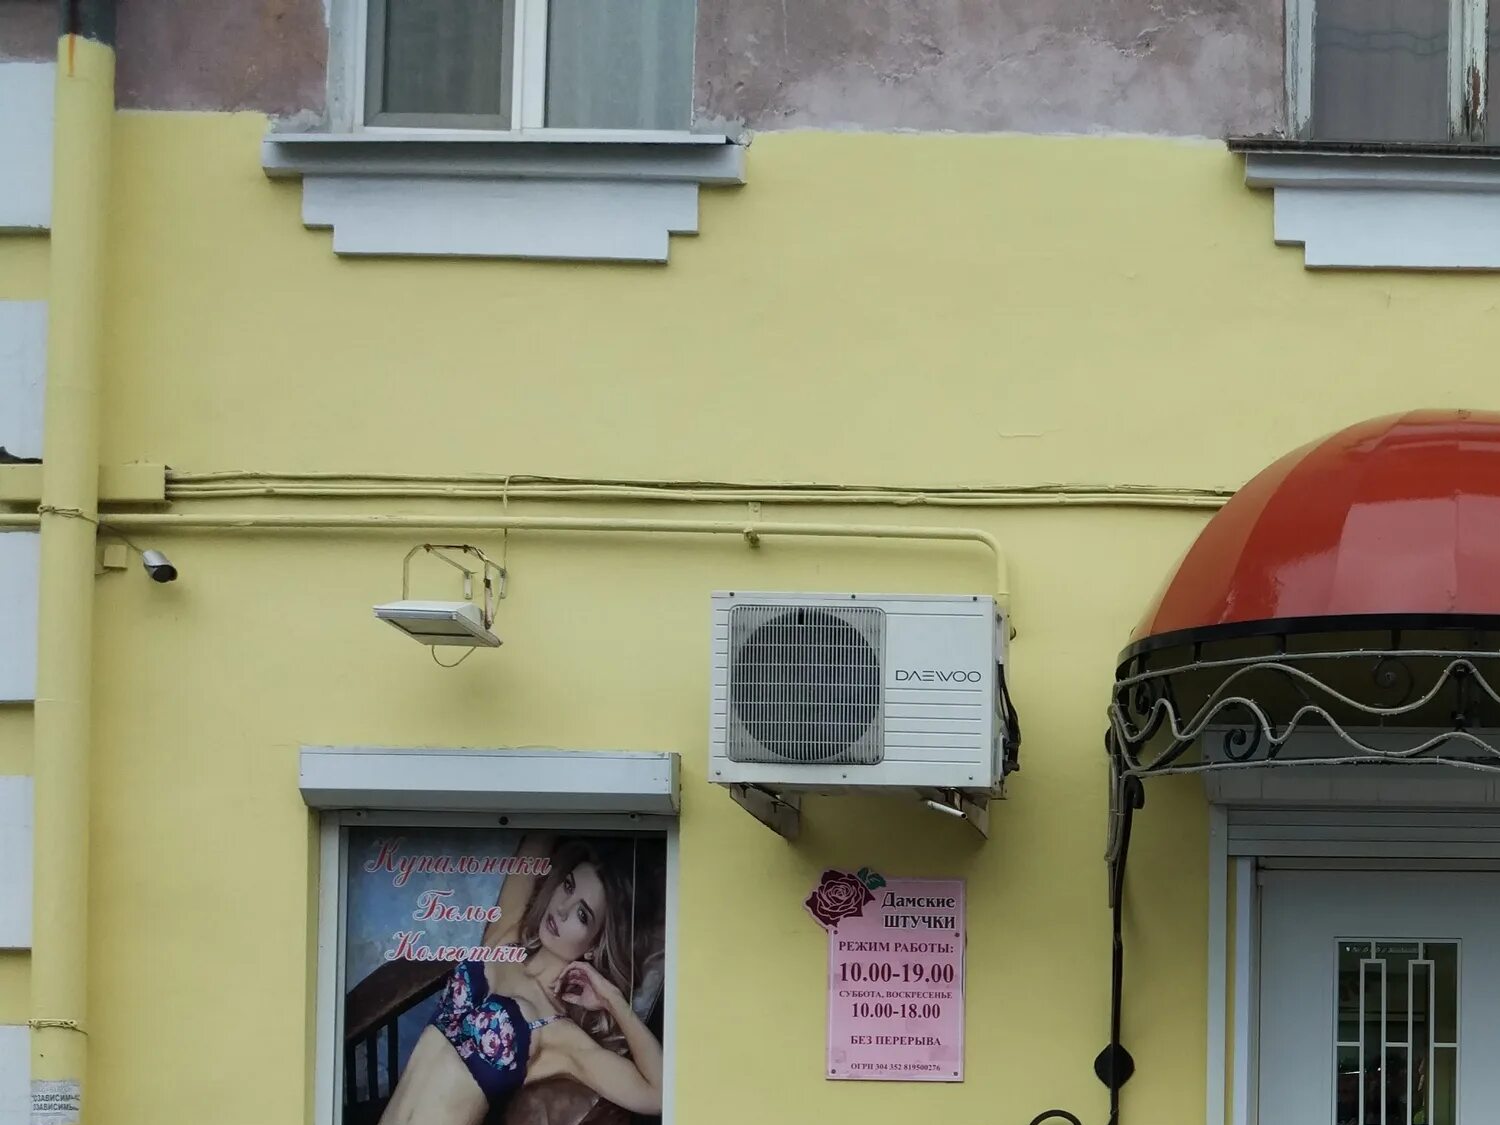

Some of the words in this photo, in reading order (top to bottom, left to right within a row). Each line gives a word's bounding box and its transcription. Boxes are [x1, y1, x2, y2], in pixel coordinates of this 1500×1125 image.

[895, 670, 981, 682] DAEWOO
[363, 834, 552, 887] Купальники
[412, 889, 502, 922] Белье
[882, 892, 955, 909] Дамские
[884, 915, 956, 930] ШТУЧКИ
[384, 930, 527, 962] Колготки
[839, 941, 890, 952] РЕЖИМ
[894, 943, 954, 954] РАБОТЫ:
[840, 962, 954, 983] 10.00-19.00
[839, 990, 884, 999] СУББОТА,
[886, 991, 953, 999] ВОСКРЕСЕНЬЕ
[852, 1003, 940, 1018] 10.00-18.00
[851, 1036, 872, 1045] БЕЗ
[875, 1036, 941, 1046] ПЕРЕРЫВА
